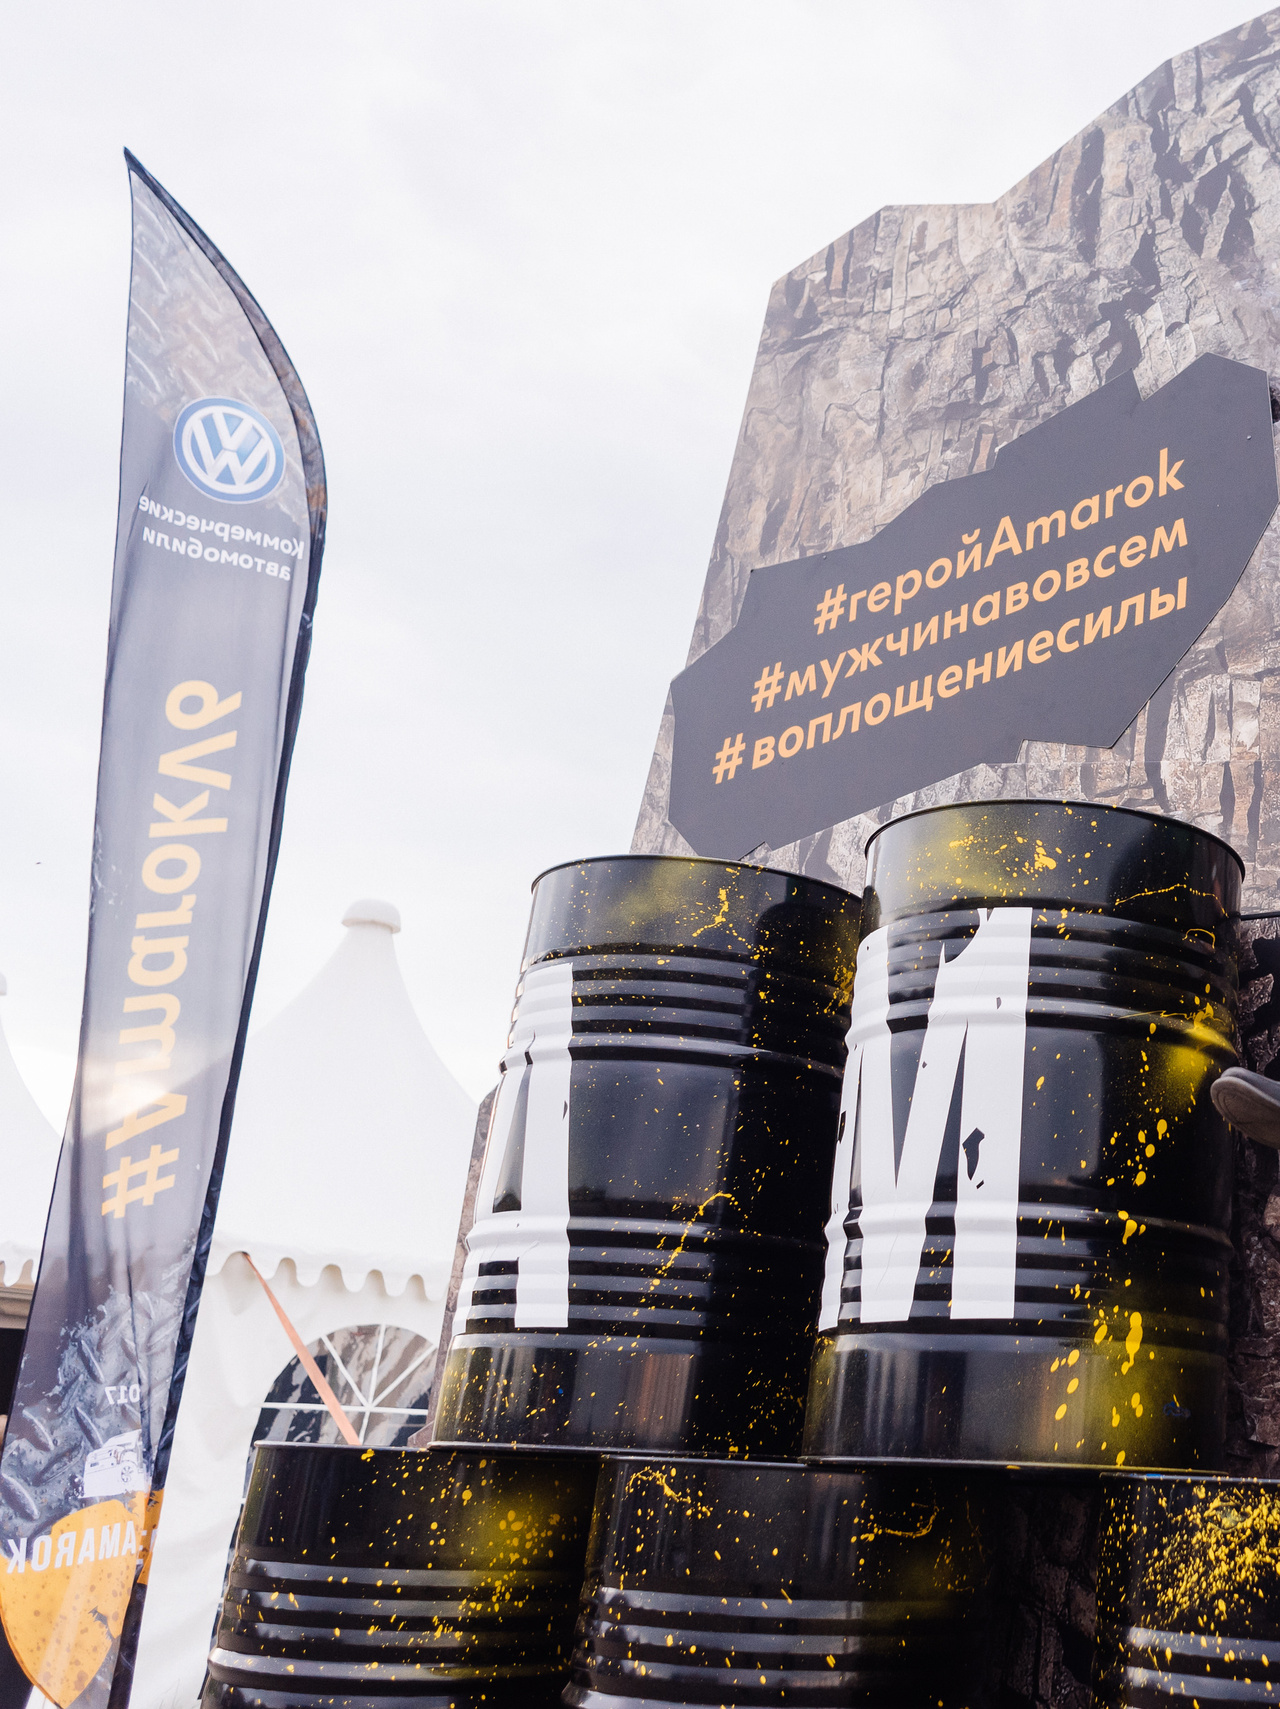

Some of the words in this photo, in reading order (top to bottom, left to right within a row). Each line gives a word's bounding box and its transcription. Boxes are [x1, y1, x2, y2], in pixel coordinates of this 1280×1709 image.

[750, 517, 1189, 714] #мужчинавовсем
[813, 447, 1186, 635] #геройAmarok
[711, 576, 1188, 785] #воплощениесилы
